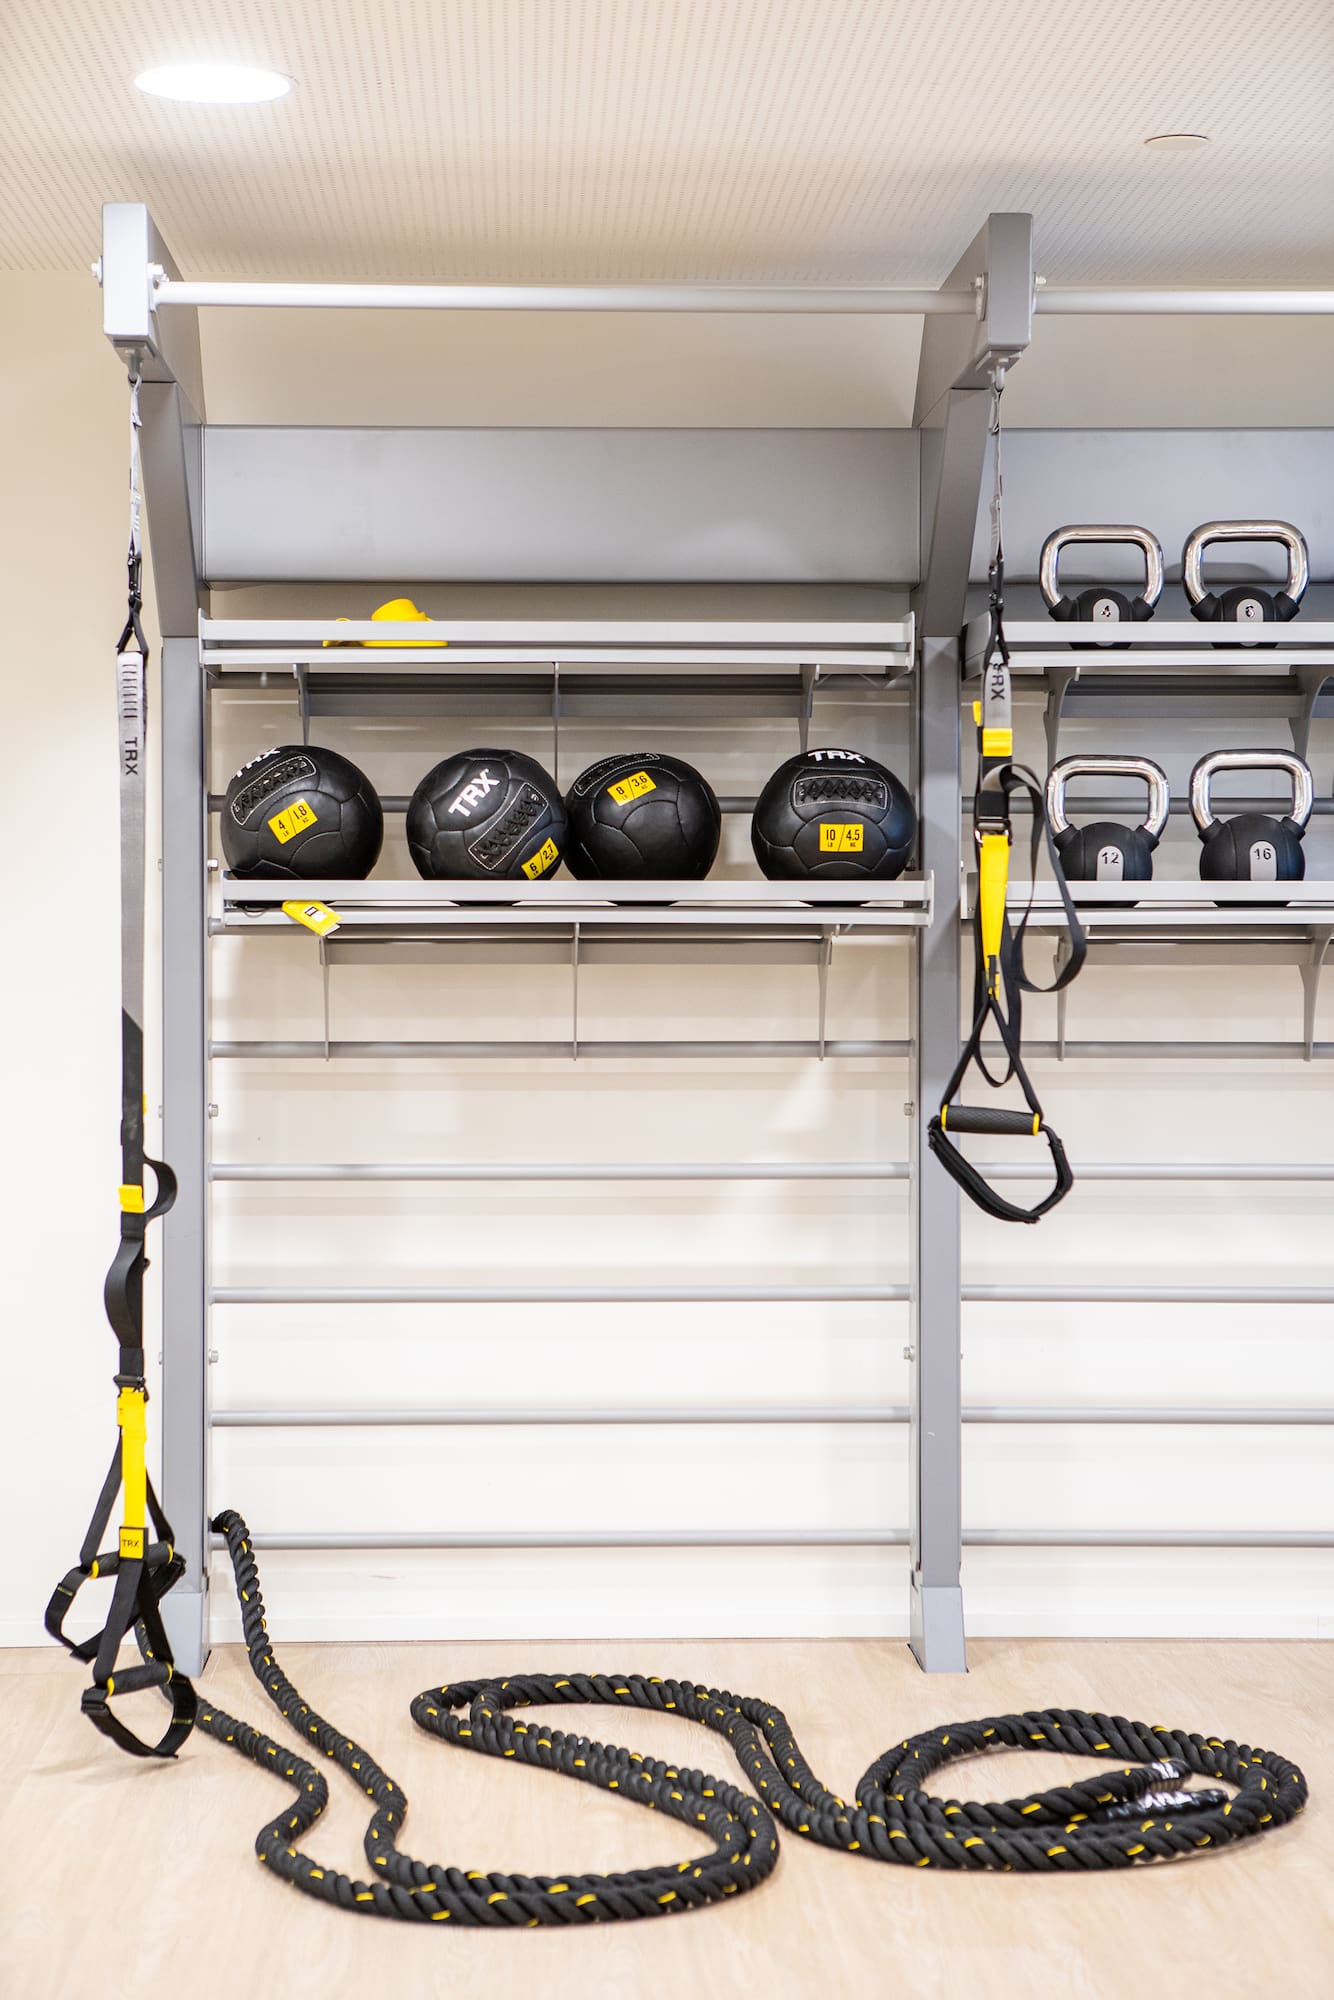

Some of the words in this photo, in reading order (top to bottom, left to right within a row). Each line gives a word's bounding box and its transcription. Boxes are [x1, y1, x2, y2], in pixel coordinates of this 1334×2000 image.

[124, 737, 138, 775] TRX
[808, 750, 866, 763] TRX
[616, 786, 625, 795] 8
[631, 775, 648, 787] 3.6
[448, 769, 500, 817] TRX
[278, 819, 286, 830] 4
[293, 805, 307, 820] 1.8
[826, 829, 836, 841] 10
[846, 829, 860, 841] 4.5
[1102, 851, 1120, 865] 12
[1254, 848, 1272, 861] 16
[529, 862, 537, 871] 6
[121, 1539, 140, 1548] TRX
